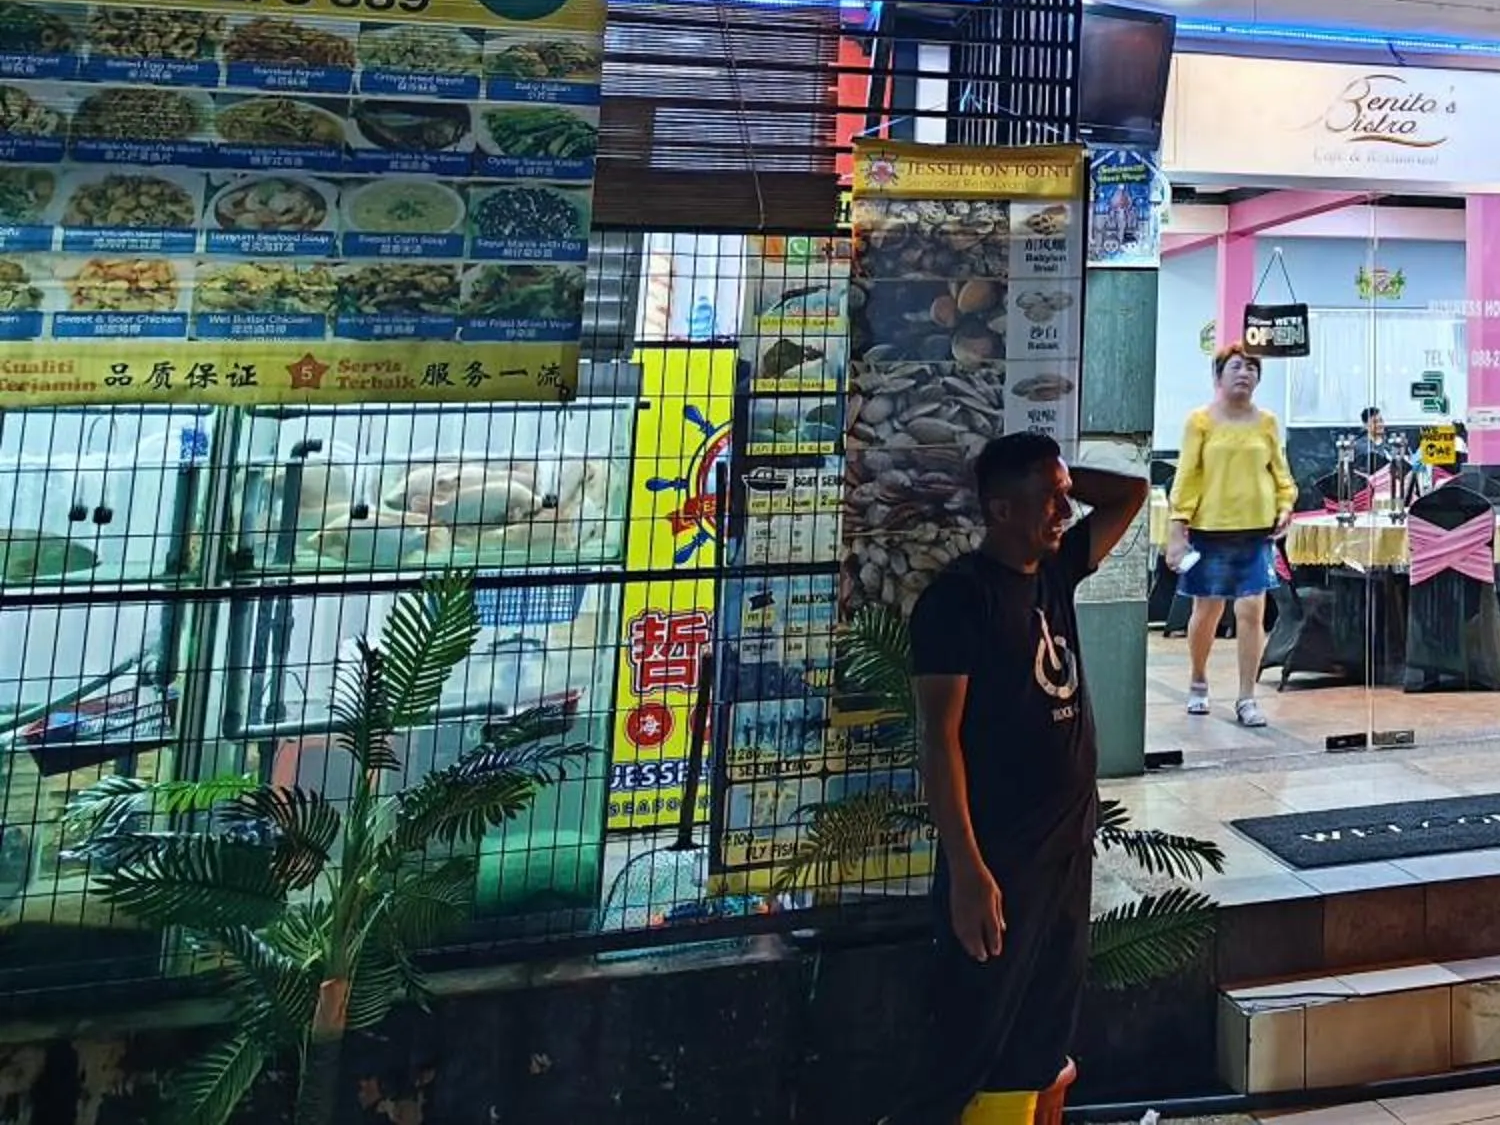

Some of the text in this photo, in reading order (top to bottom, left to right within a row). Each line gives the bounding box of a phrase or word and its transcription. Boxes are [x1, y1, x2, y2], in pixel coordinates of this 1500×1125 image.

[1326, 74, 1457, 132] Benito's
[1014, 163, 1073, 178] POINT
[1246, 326, 1305, 346] OPEN
[104, 361, 260, 390] 品质保证
[301, 365, 313, 380] 5
[420, 361, 566, 388] 服务一流
[629, 609, 707, 695] 哲
